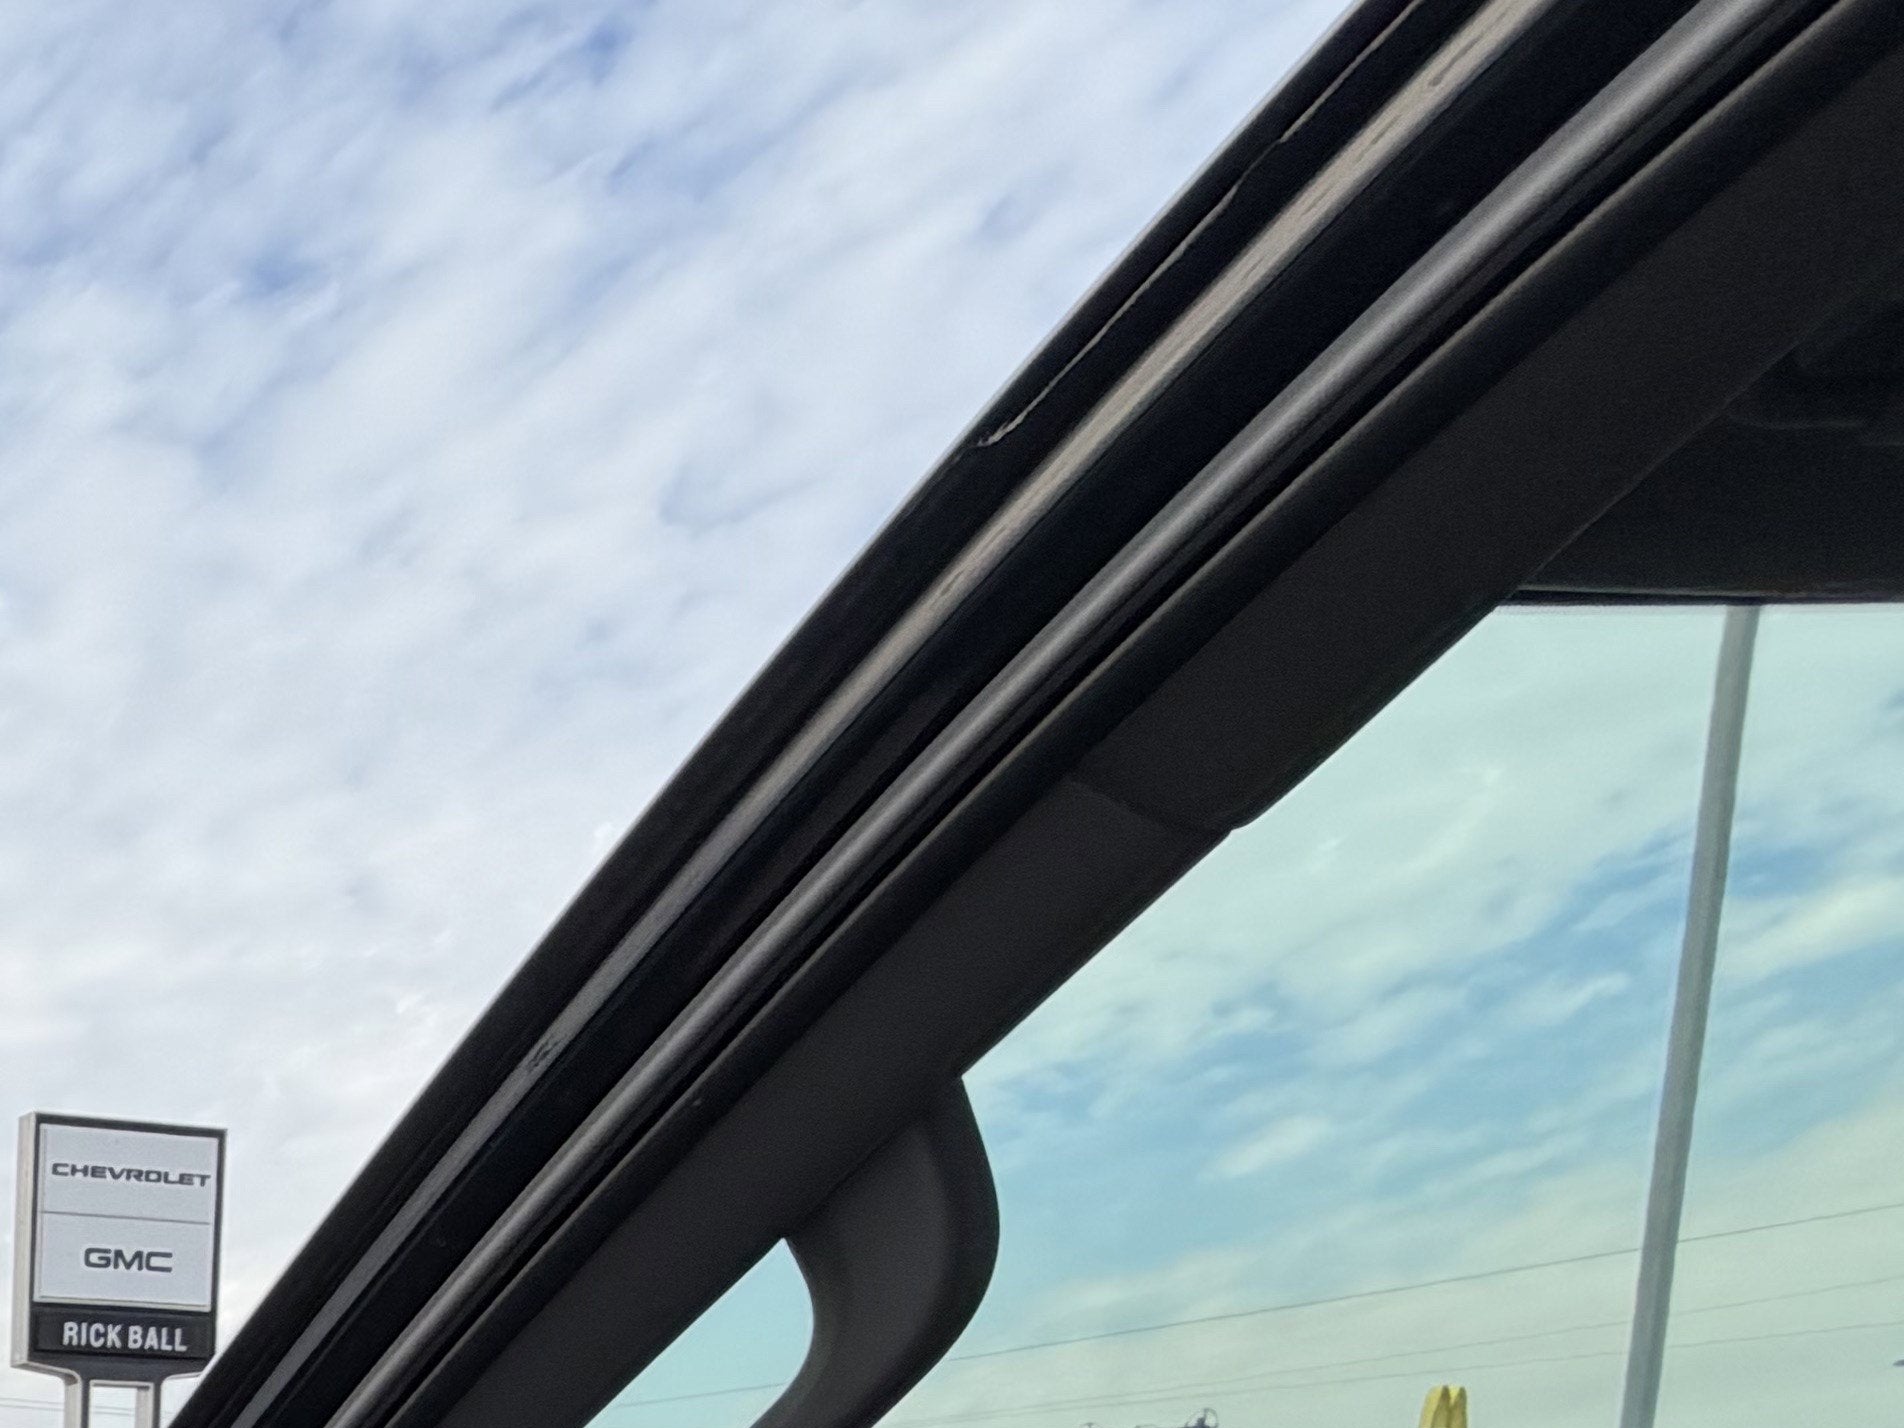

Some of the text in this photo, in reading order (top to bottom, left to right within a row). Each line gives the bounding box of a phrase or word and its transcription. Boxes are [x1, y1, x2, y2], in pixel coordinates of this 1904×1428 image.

[50, 1162, 211, 1187] CHEVROLET
[83, 1247, 174, 1273] GMC
[61, 1321, 188, 1352] RICK BALL
